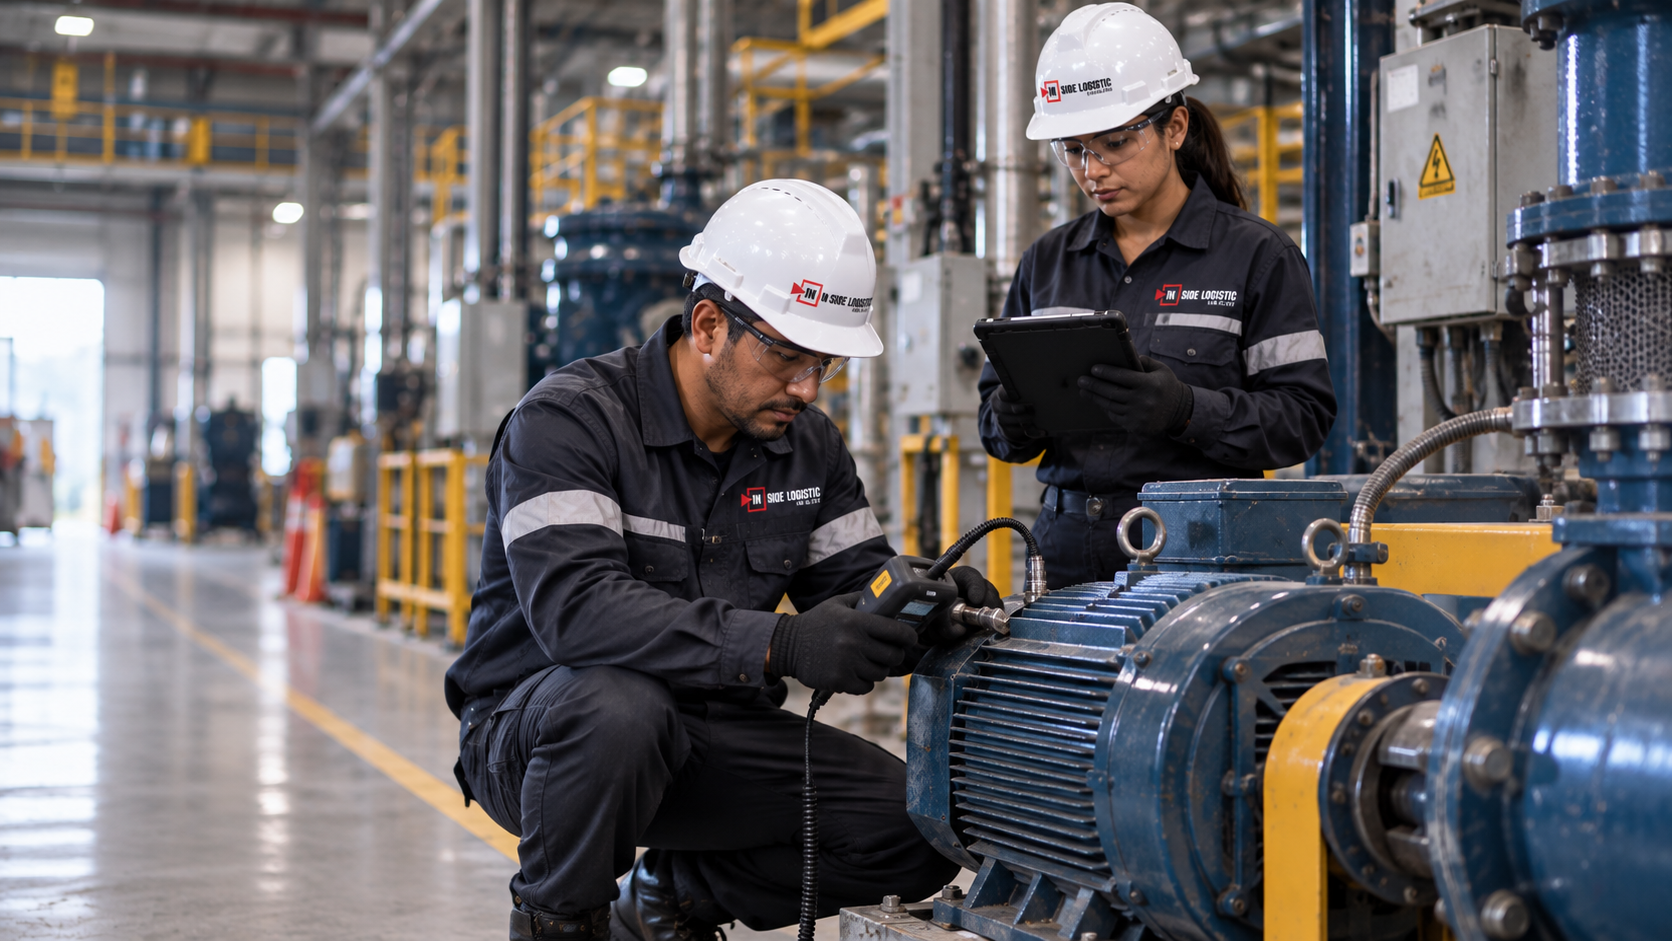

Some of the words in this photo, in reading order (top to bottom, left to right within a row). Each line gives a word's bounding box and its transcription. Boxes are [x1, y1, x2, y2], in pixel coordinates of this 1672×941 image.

[1060, 84, 1077, 95] SIDE
[1078, 77, 1112, 92] LOGISTIC
[804, 287, 817, 300] IN
[1165, 290, 1176, 300] IN
[1181, 290, 1200, 300] SIDE
[1201, 290, 1238, 301] LOGISTIC
[752, 494, 762, 505] IN
[767, 491, 785, 504] SIDE
[786, 486, 821, 502] LOGISTIC
